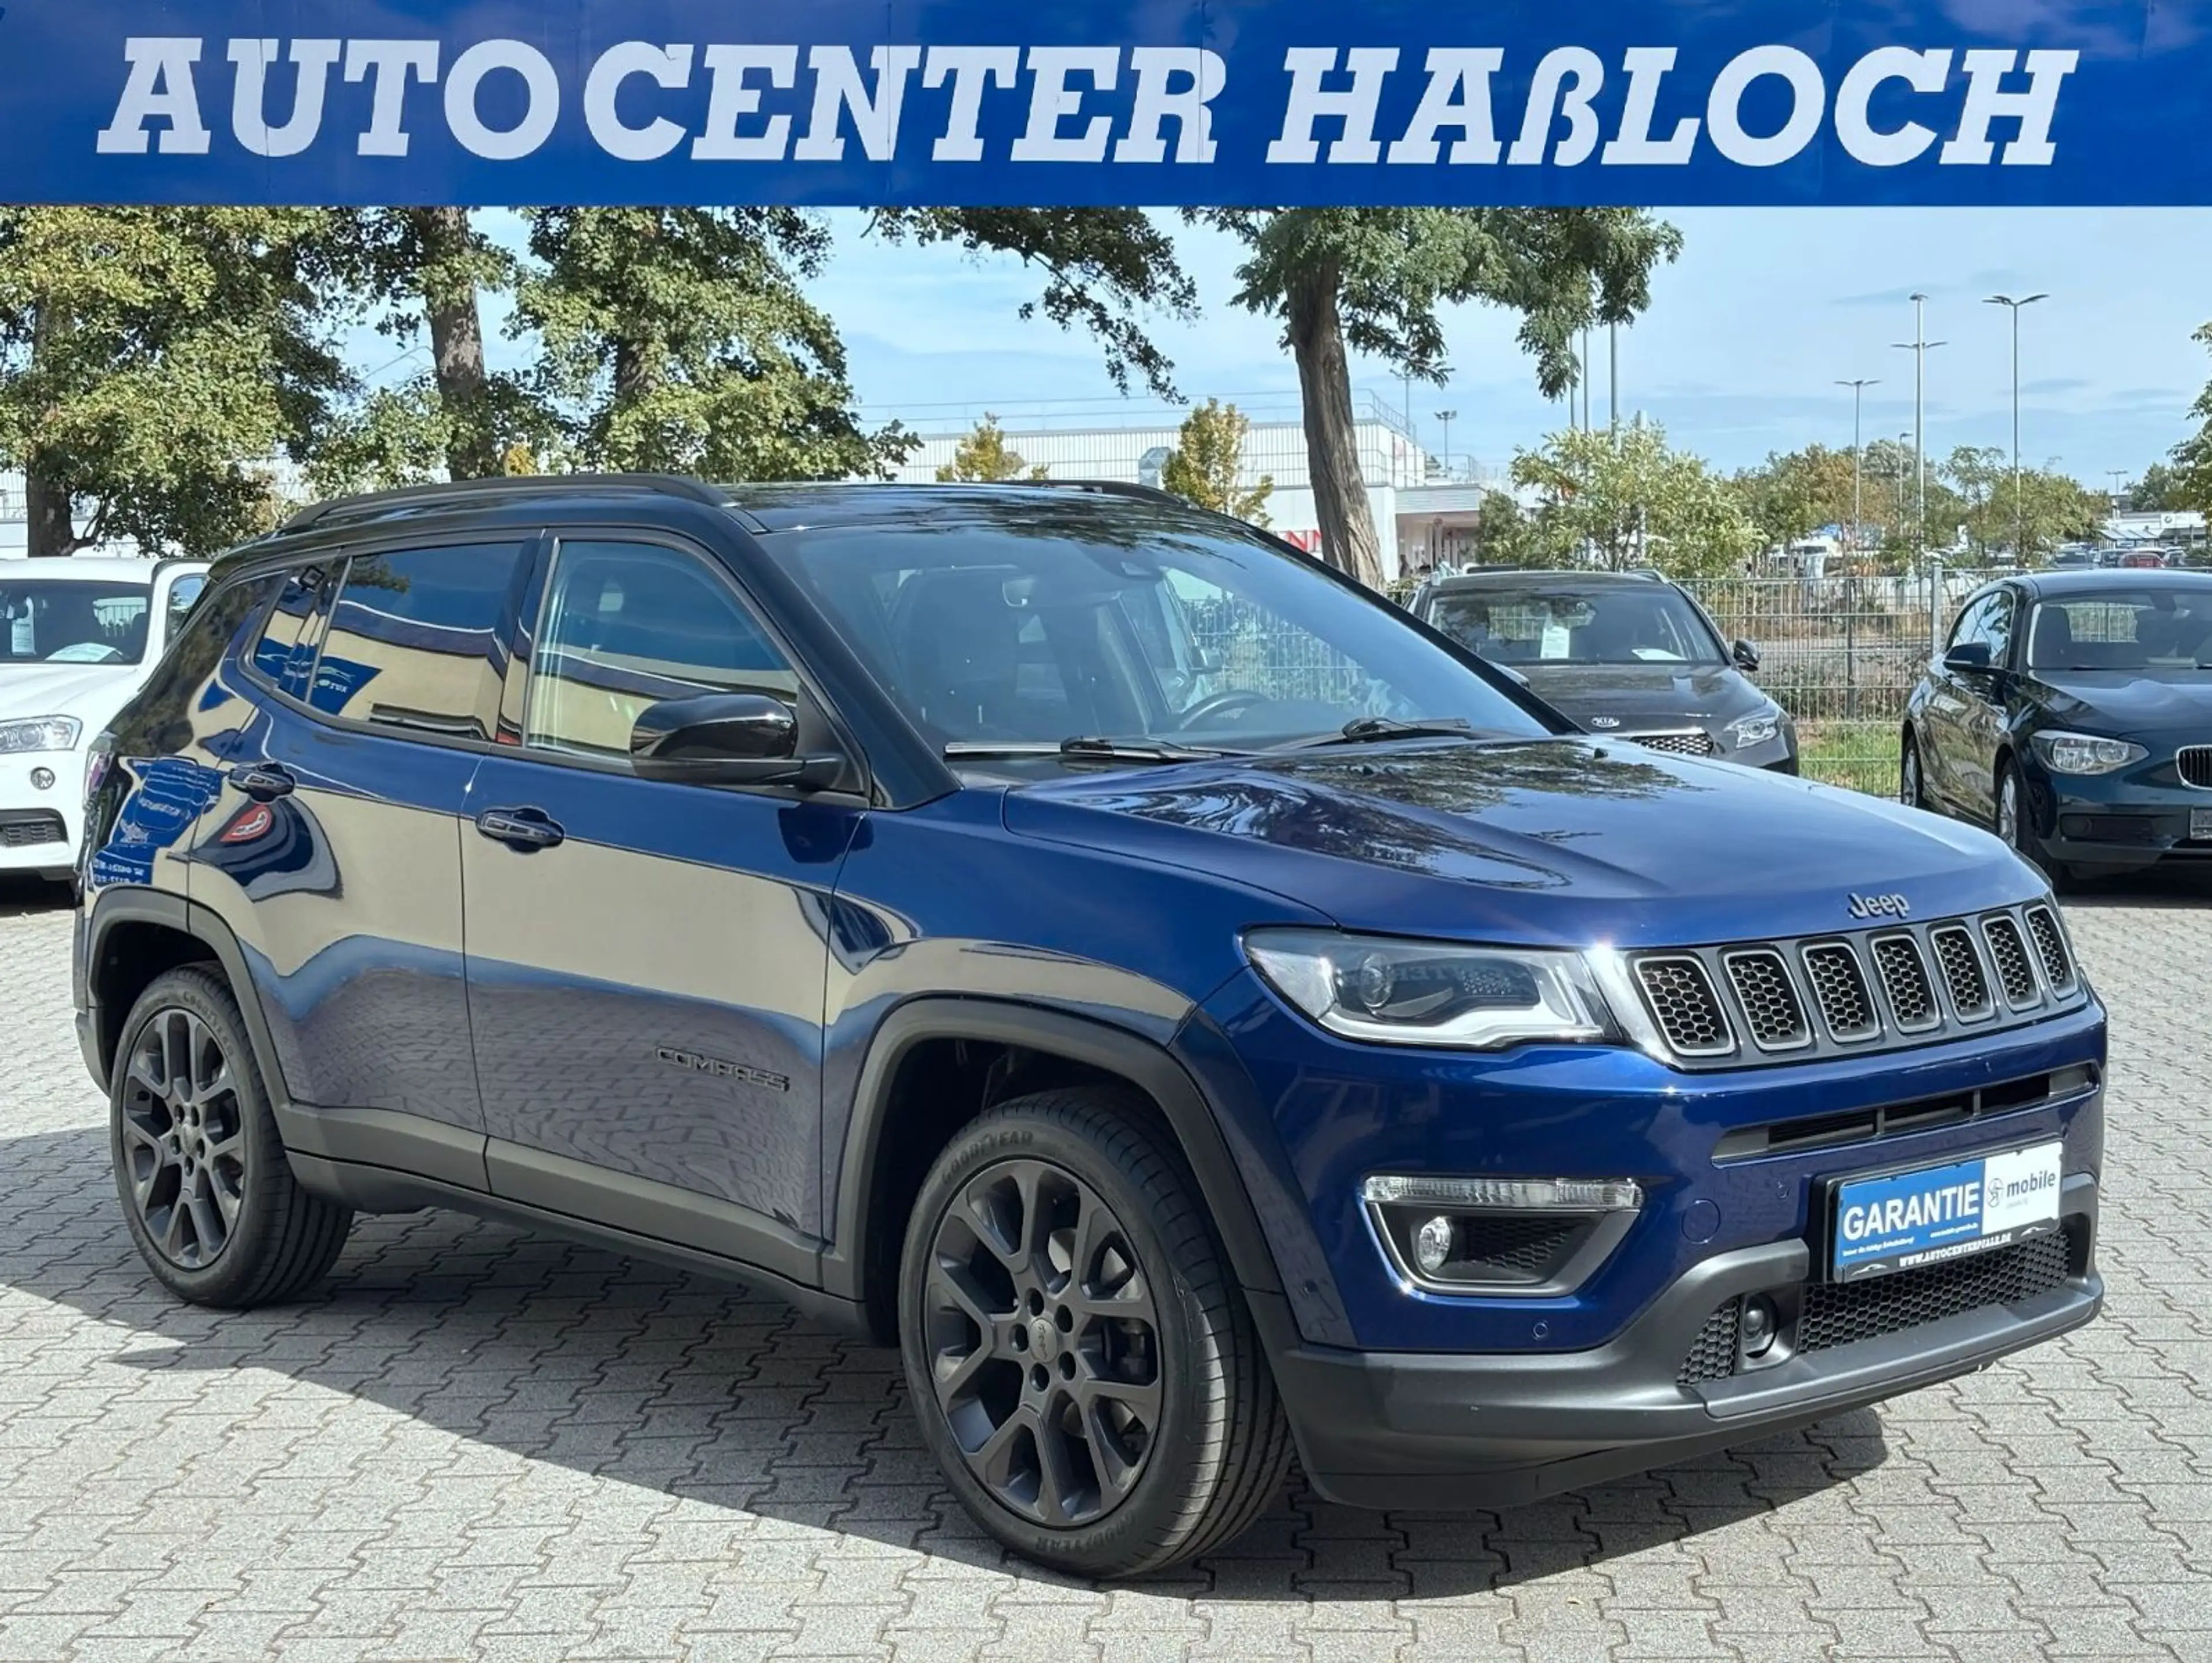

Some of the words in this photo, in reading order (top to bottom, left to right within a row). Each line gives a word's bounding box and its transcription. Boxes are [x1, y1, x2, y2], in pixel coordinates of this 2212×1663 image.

[96, 37, 1226, 163] AUTOCENTER
[1265, 44, 2079, 166] HAßLOCH
[1847, 892, 1911, 919] Jeep
[655, 1046, 790, 1091] COMPASS
[2006, 1170, 2056, 1198] mobile
[1842, 1181, 1980, 1240] GARANTIE
